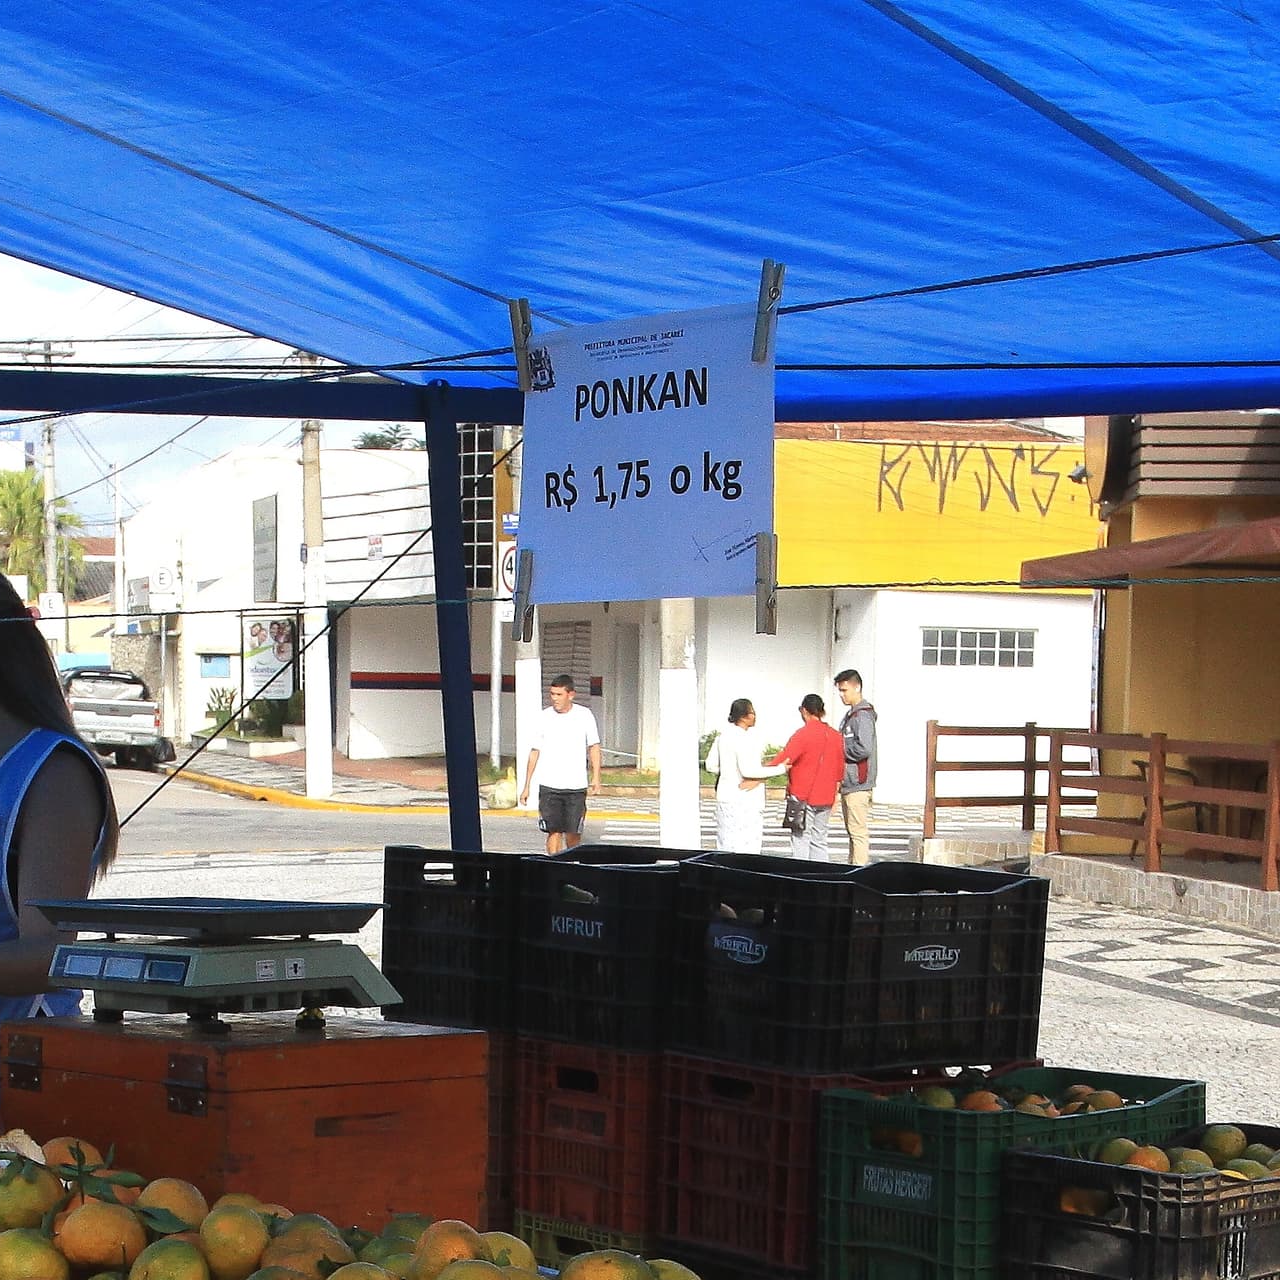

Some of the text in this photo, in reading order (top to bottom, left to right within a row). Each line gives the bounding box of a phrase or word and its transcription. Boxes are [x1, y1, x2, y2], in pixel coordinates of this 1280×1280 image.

[617, 335, 647, 345] MUNICIPAL
[576, 368, 707, 421] PONKAN
[546, 451, 742, 512] R$ 1,75 o kg
[551, 915, 603, 938] KIFRUT
